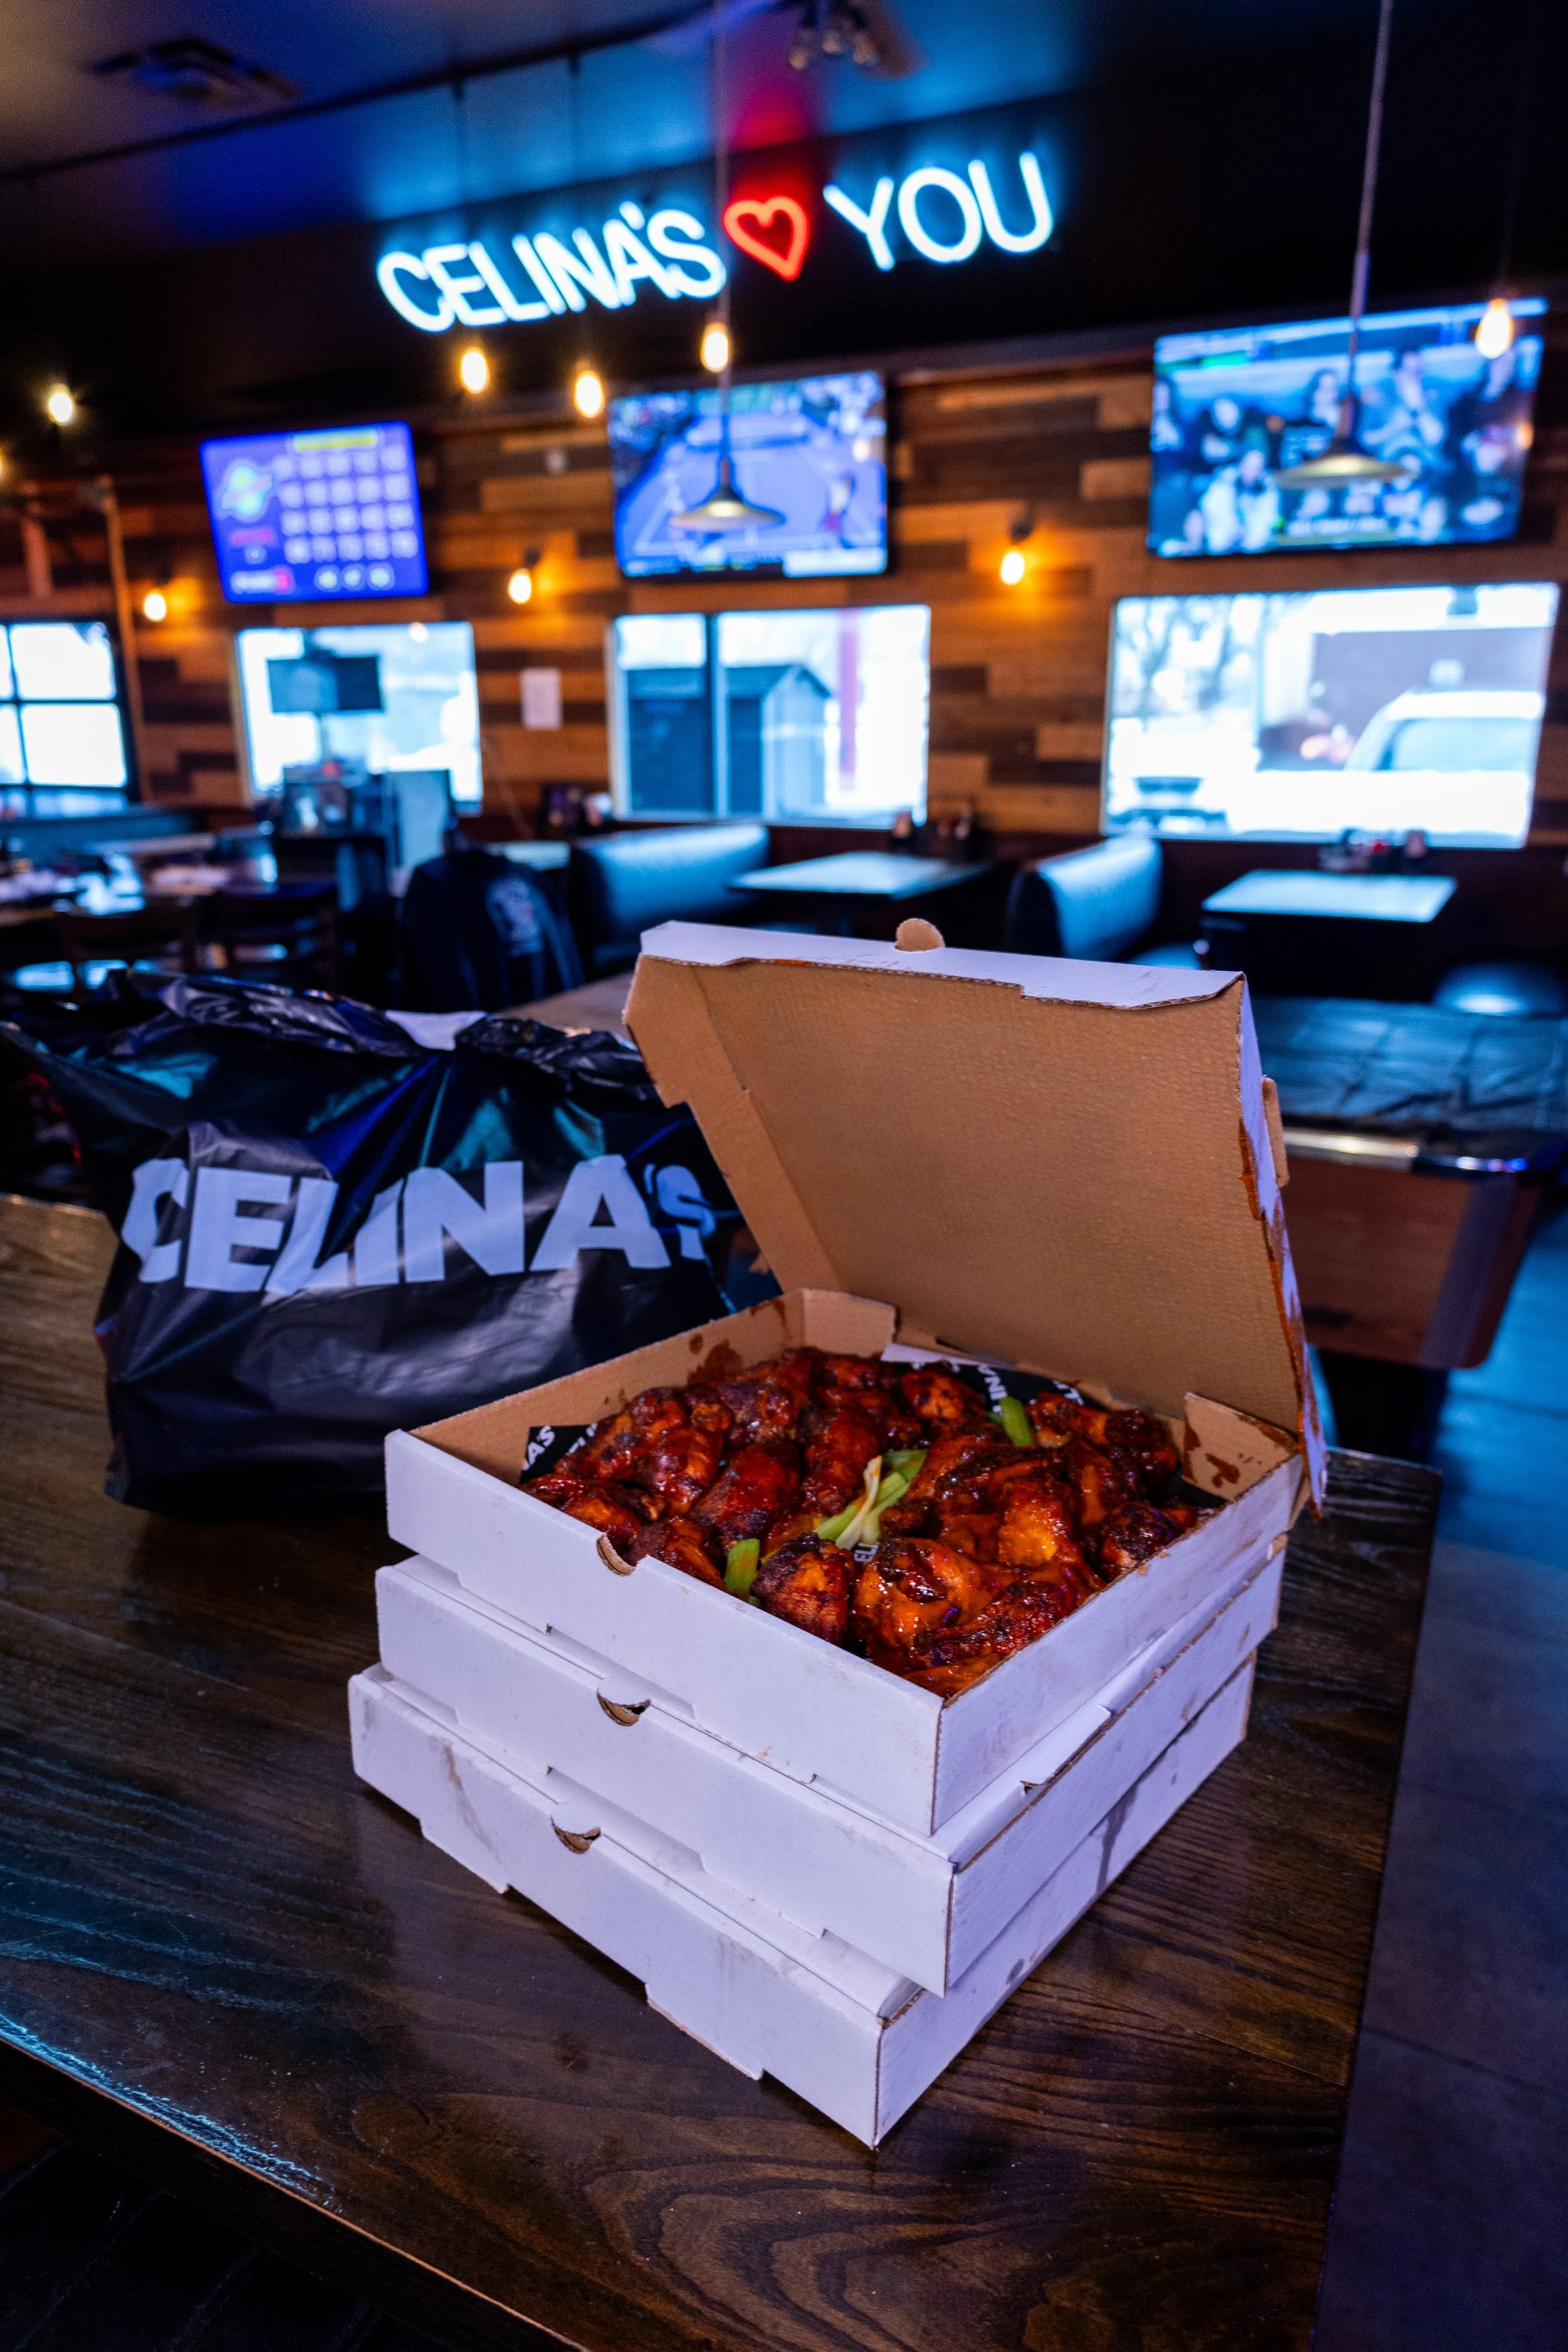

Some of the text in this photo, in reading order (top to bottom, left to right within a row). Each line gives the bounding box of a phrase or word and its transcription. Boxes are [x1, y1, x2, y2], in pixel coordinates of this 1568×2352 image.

[376, 151, 1052, 332] CELINA'S YOU
[122, 1153, 716, 1306] CELINA'S
